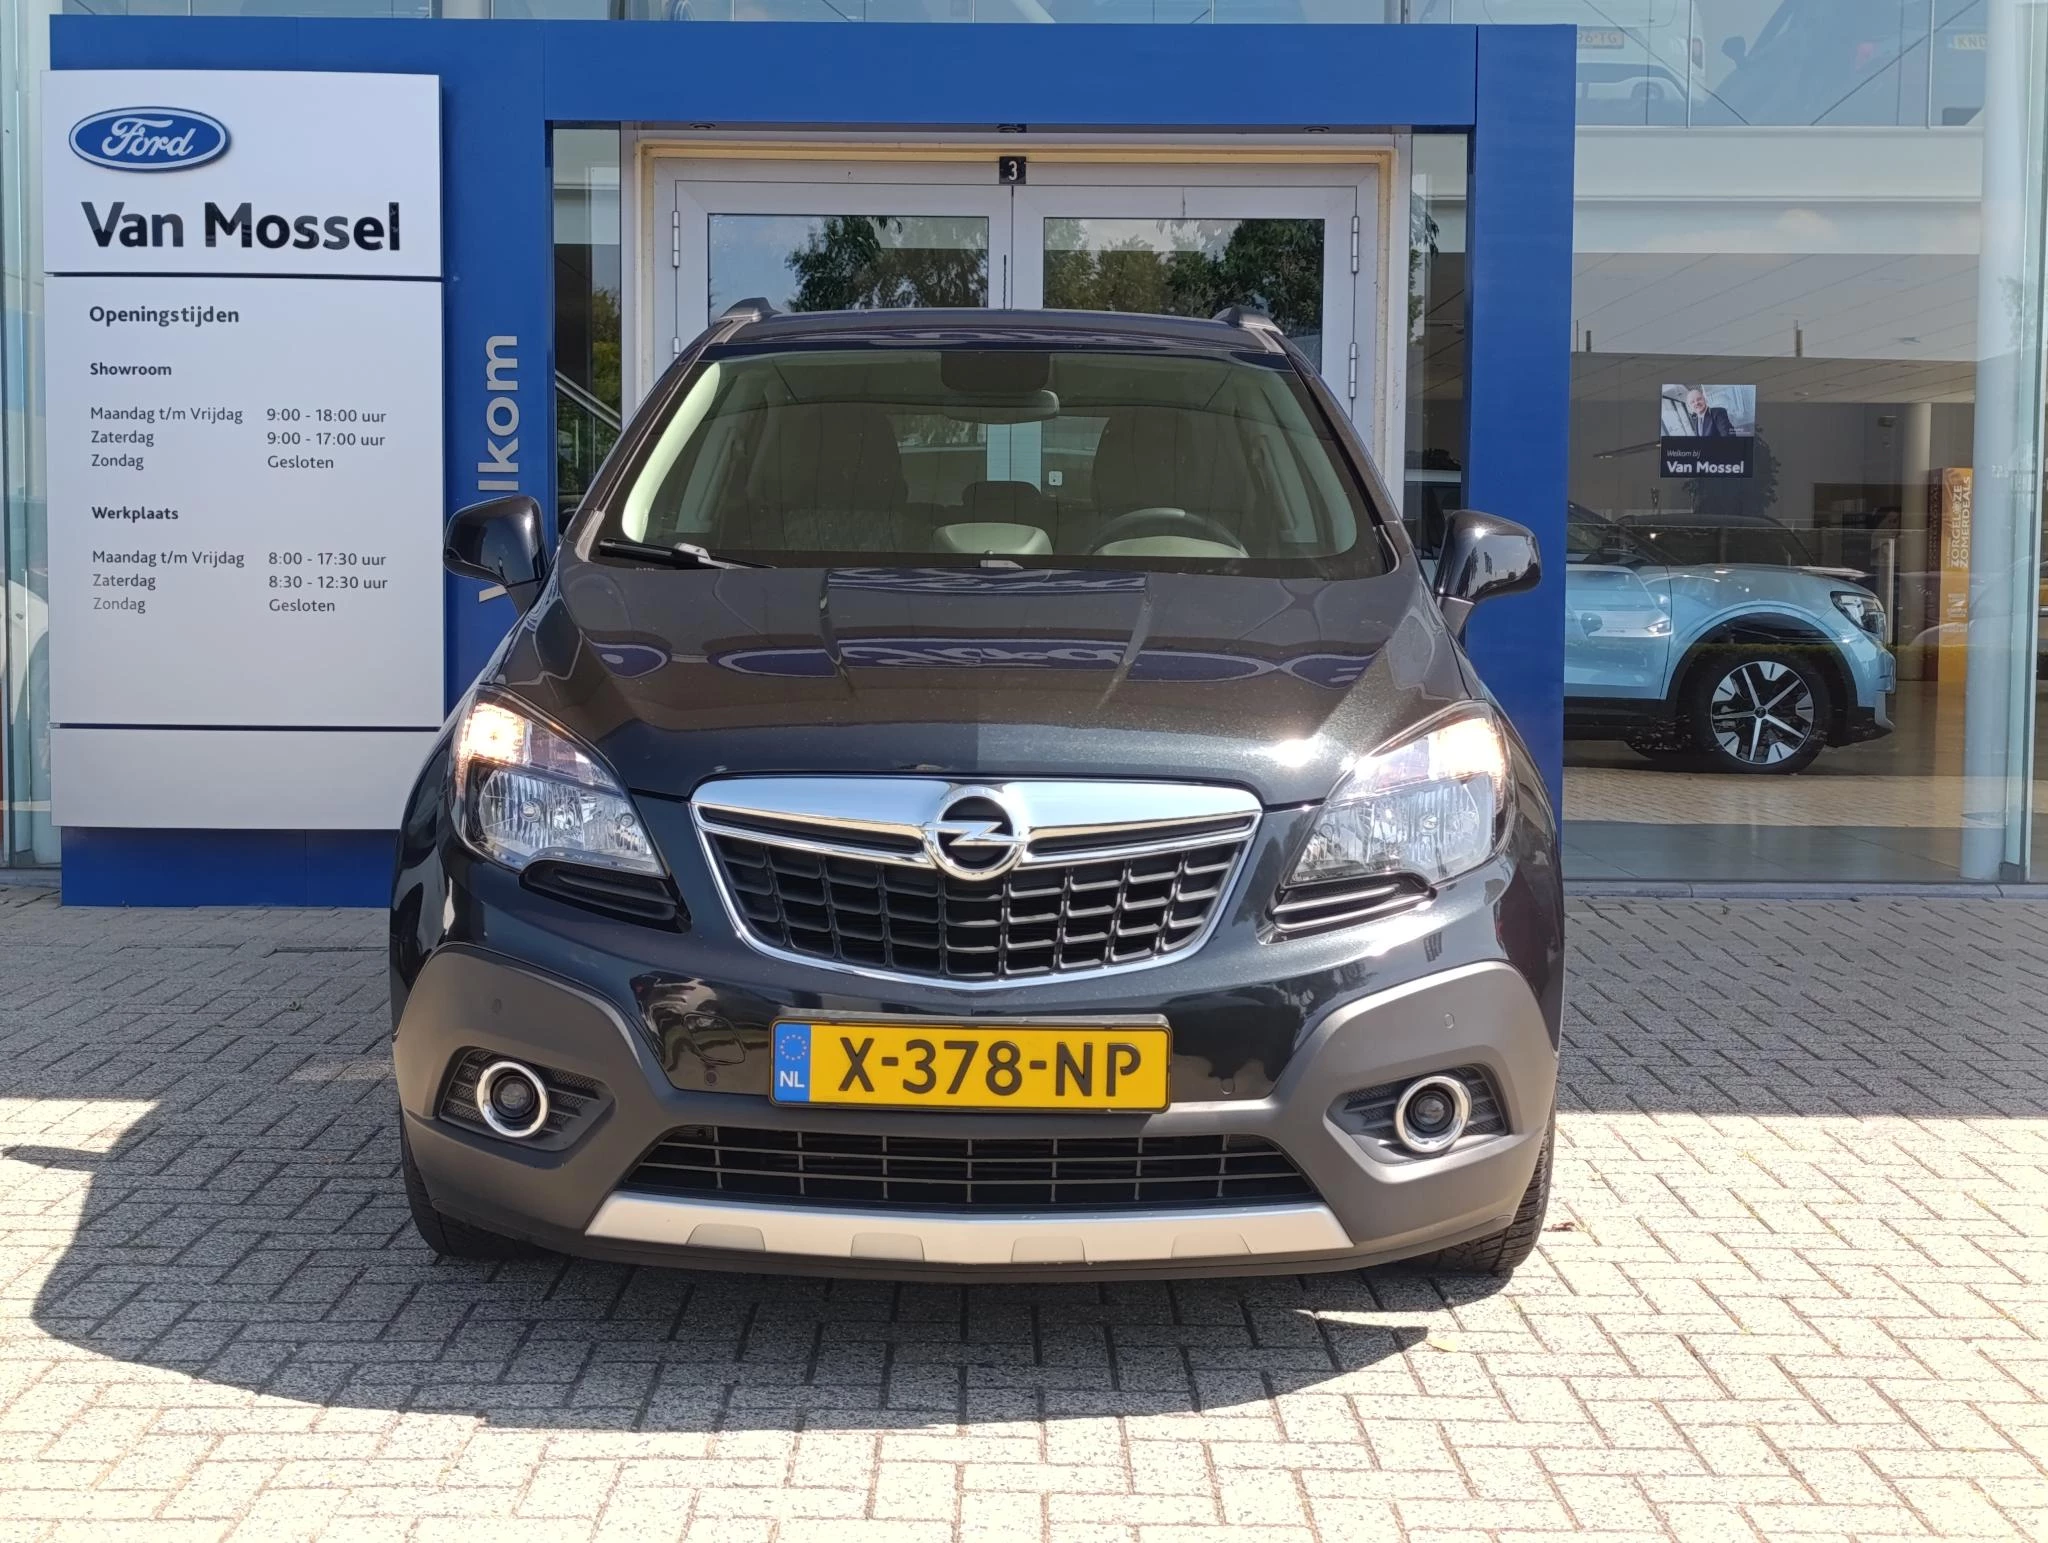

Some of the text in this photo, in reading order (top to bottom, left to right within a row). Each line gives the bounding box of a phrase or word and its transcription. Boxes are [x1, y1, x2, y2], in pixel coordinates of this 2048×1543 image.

[102, 117, 197, 157] Ford
[1008, 160, 1018, 181] 3
[81, 202, 400, 251] Van Mossel
[90, 305, 239, 327] Openingstijden
[90, 361, 171, 376] Showroom
[91, 407, 244, 425] Maandag t/m Vrijdag
[267, 408, 300, 422] 9:00
[316, 409, 357, 422] 18:00
[362, 412, 387, 423] uur
[91, 430, 154, 447] Zaterdag
[267, 432, 300, 445] 9:00
[316, 433, 356, 446] 17:00
[361, 436, 386, 446] uur
[91, 453, 144, 471] Zondag
[267, 454, 334, 469] Gesloten
[1692, 449, 1701, 459] bij
[1666, 460, 1744, 473] Van Mossel
[92, 506, 179, 523] Werkplaats
[1959, 477, 1971, 568] ZOMERDEALS
[93, 550, 245, 568] Maandag t/m Vrijdag
[269, 551, 302, 566] 8:00
[317, 552, 357, 566] 17:30
[362, 556, 387, 566] uur
[93, 574, 156, 591] Zaterdag
[269, 575, 302, 589] 8:30
[318, 576, 358, 589] 12:30
[363, 579, 389, 589] uur
[93, 597, 146, 615] Zondag
[269, 598, 336, 613] Gesloten
[838, 1037, 1142, 1097] X-378-NP
[780, 1070, 805, 1088] NL
